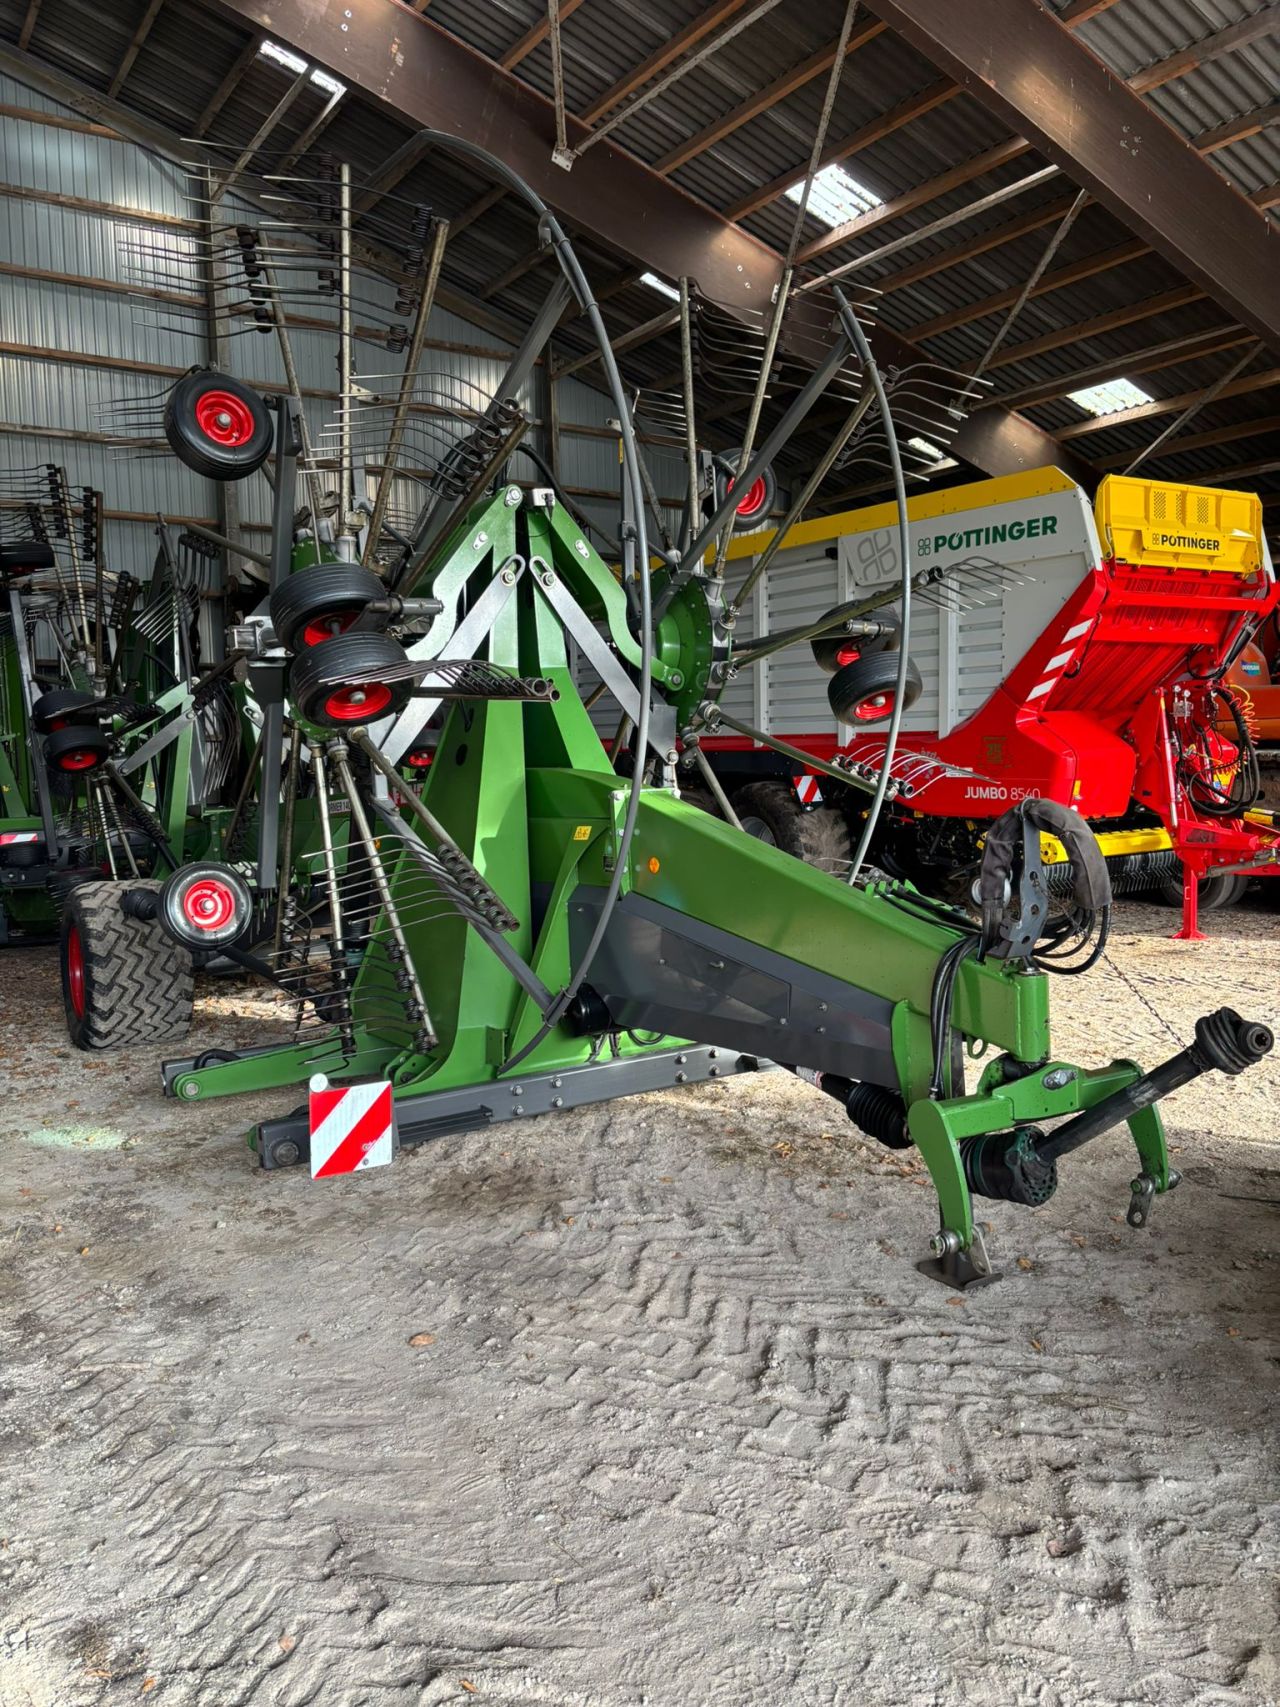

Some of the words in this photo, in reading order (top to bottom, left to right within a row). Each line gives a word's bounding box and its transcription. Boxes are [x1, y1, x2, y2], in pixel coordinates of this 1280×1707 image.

[934, 515, 1058, 553] PÖTTINGER
[964, 786, 1008, 799] JUMBO
[1010, 787, 1041, 801] 8540
